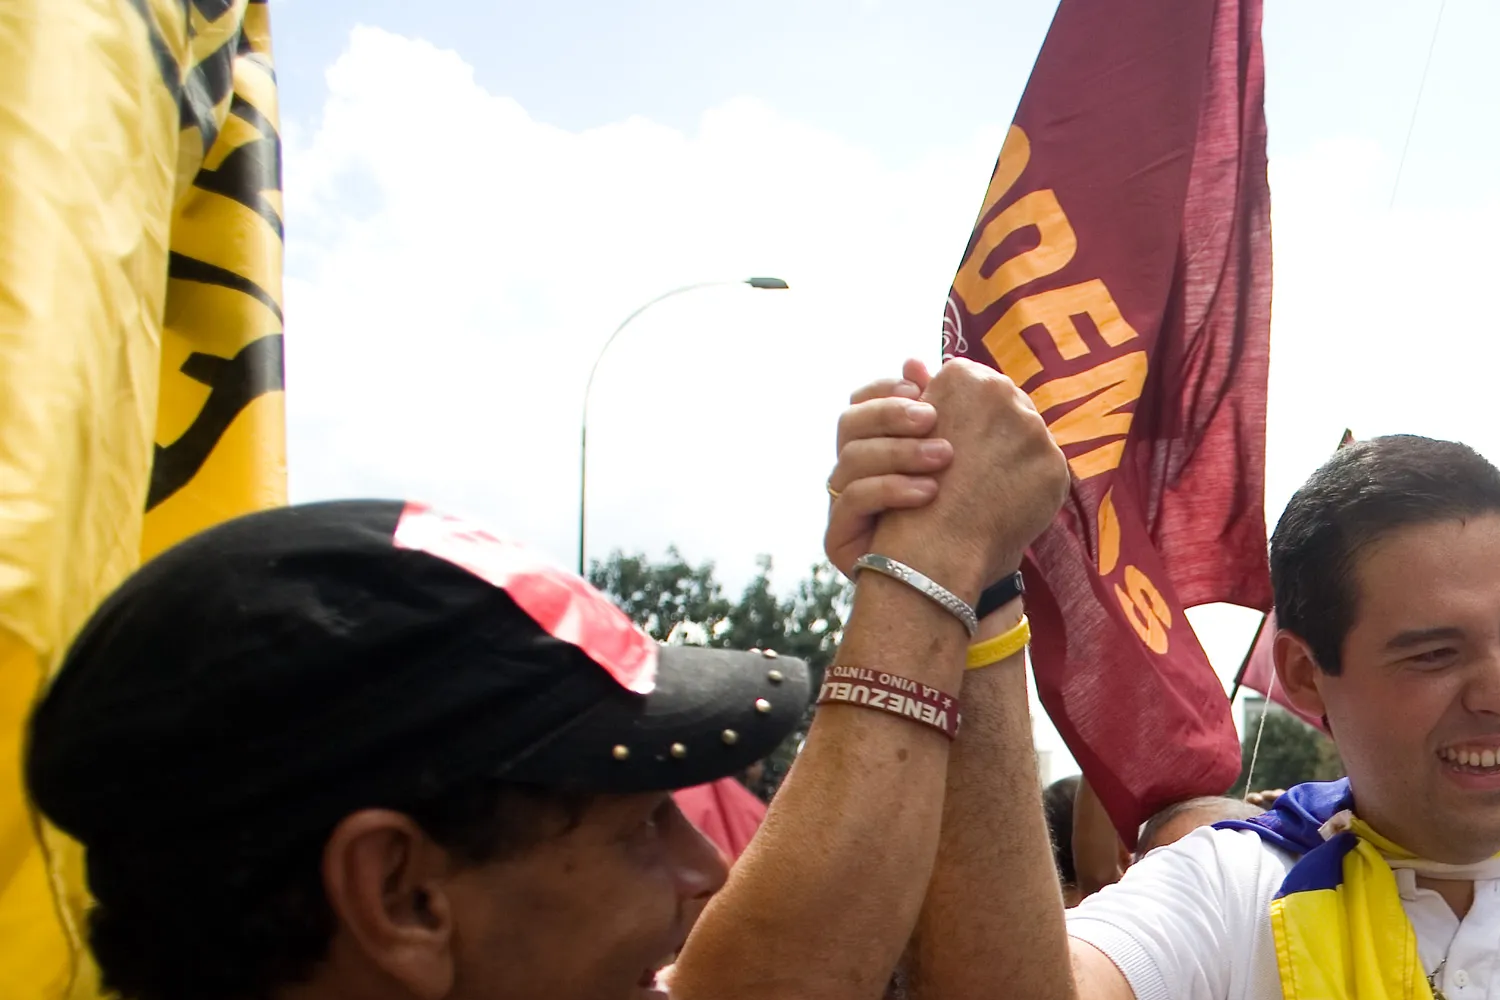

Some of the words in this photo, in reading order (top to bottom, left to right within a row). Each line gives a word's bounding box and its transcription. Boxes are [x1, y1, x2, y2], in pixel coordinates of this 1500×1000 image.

[833, 666, 875, 682] TINTO
[879, 673, 918, 694] VINO
[922, 685, 940, 701] LA
